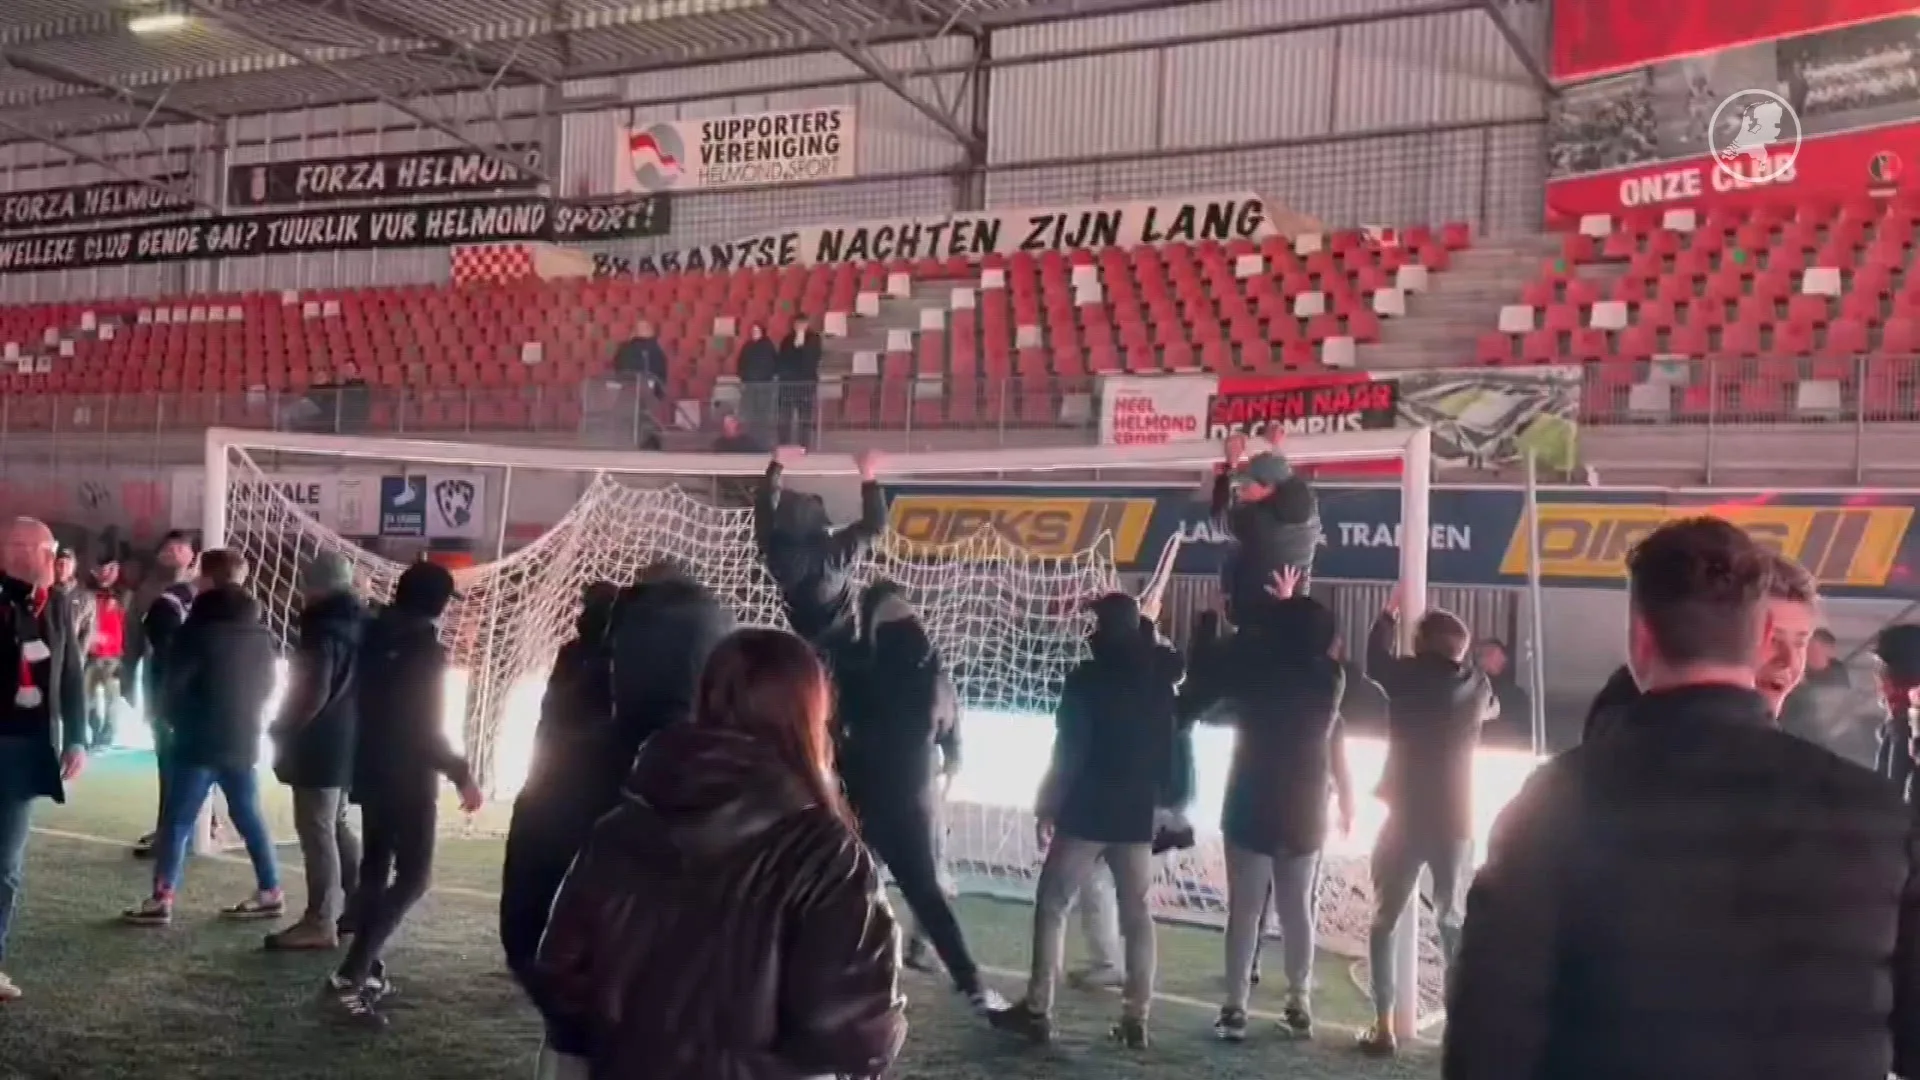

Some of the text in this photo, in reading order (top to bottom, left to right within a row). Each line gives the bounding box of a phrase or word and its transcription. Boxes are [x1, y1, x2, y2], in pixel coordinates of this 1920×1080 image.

[702, 110, 841, 142] SUPPORTERS
[700, 134, 840, 165] VERENIGING
[295, 161, 386, 195] FORZA
[1620, 152, 1797, 206] ONZE CLUB
[3, 178, 192, 223] FORZA HELMO
[0, 198, 656, 268] WELLEKE CLUB BENDE GAI? TUURLIK VUR HELMOND SPORT!
[816, 216, 1001, 263] NACHTEN
[1021, 209, 1123, 250] ZIJN
[1140, 199, 1265, 243] LANG
[1115, 396, 1155, 414] HEEL
[1212, 384, 1392, 424] SAMEN NAAR
[1114, 414, 1197, 432] HELMOND
[1250, 412, 1363, 439] CMPUS
[899, 506, 1074, 546] DIRKS
[1338, 521, 1471, 551] TRAEN
